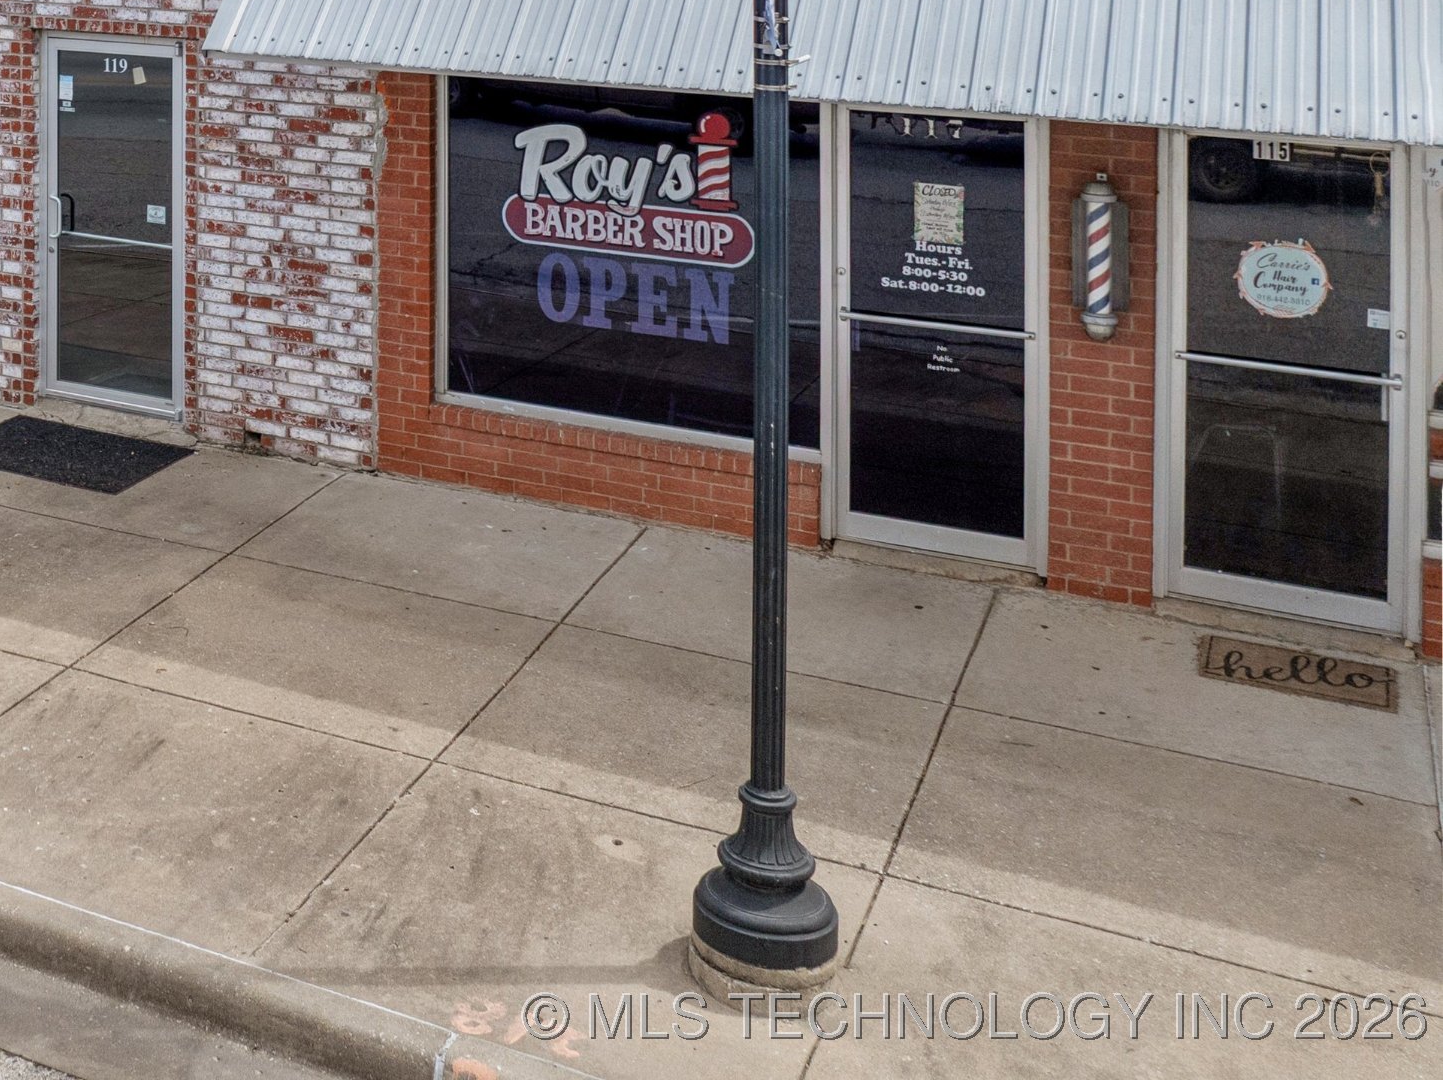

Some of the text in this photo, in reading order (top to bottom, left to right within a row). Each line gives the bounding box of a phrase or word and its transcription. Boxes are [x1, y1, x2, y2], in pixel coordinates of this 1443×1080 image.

[103, 58, 128, 74] 119
[1256, 141, 1288, 160] 115
[514, 123, 696, 215] Roy's
[523, 202, 734, 257] BARBER SHOP
[915, 240, 963, 255] Hours
[1257, 253, 1310, 271] Carrie's
[1253, 271, 1307, 296] Company
[1273, 270, 1297, 283] Hair
[537, 252, 735, 345] OPEN
[932, 354, 953, 363] Public
[1221, 650, 1376, 689] hello
